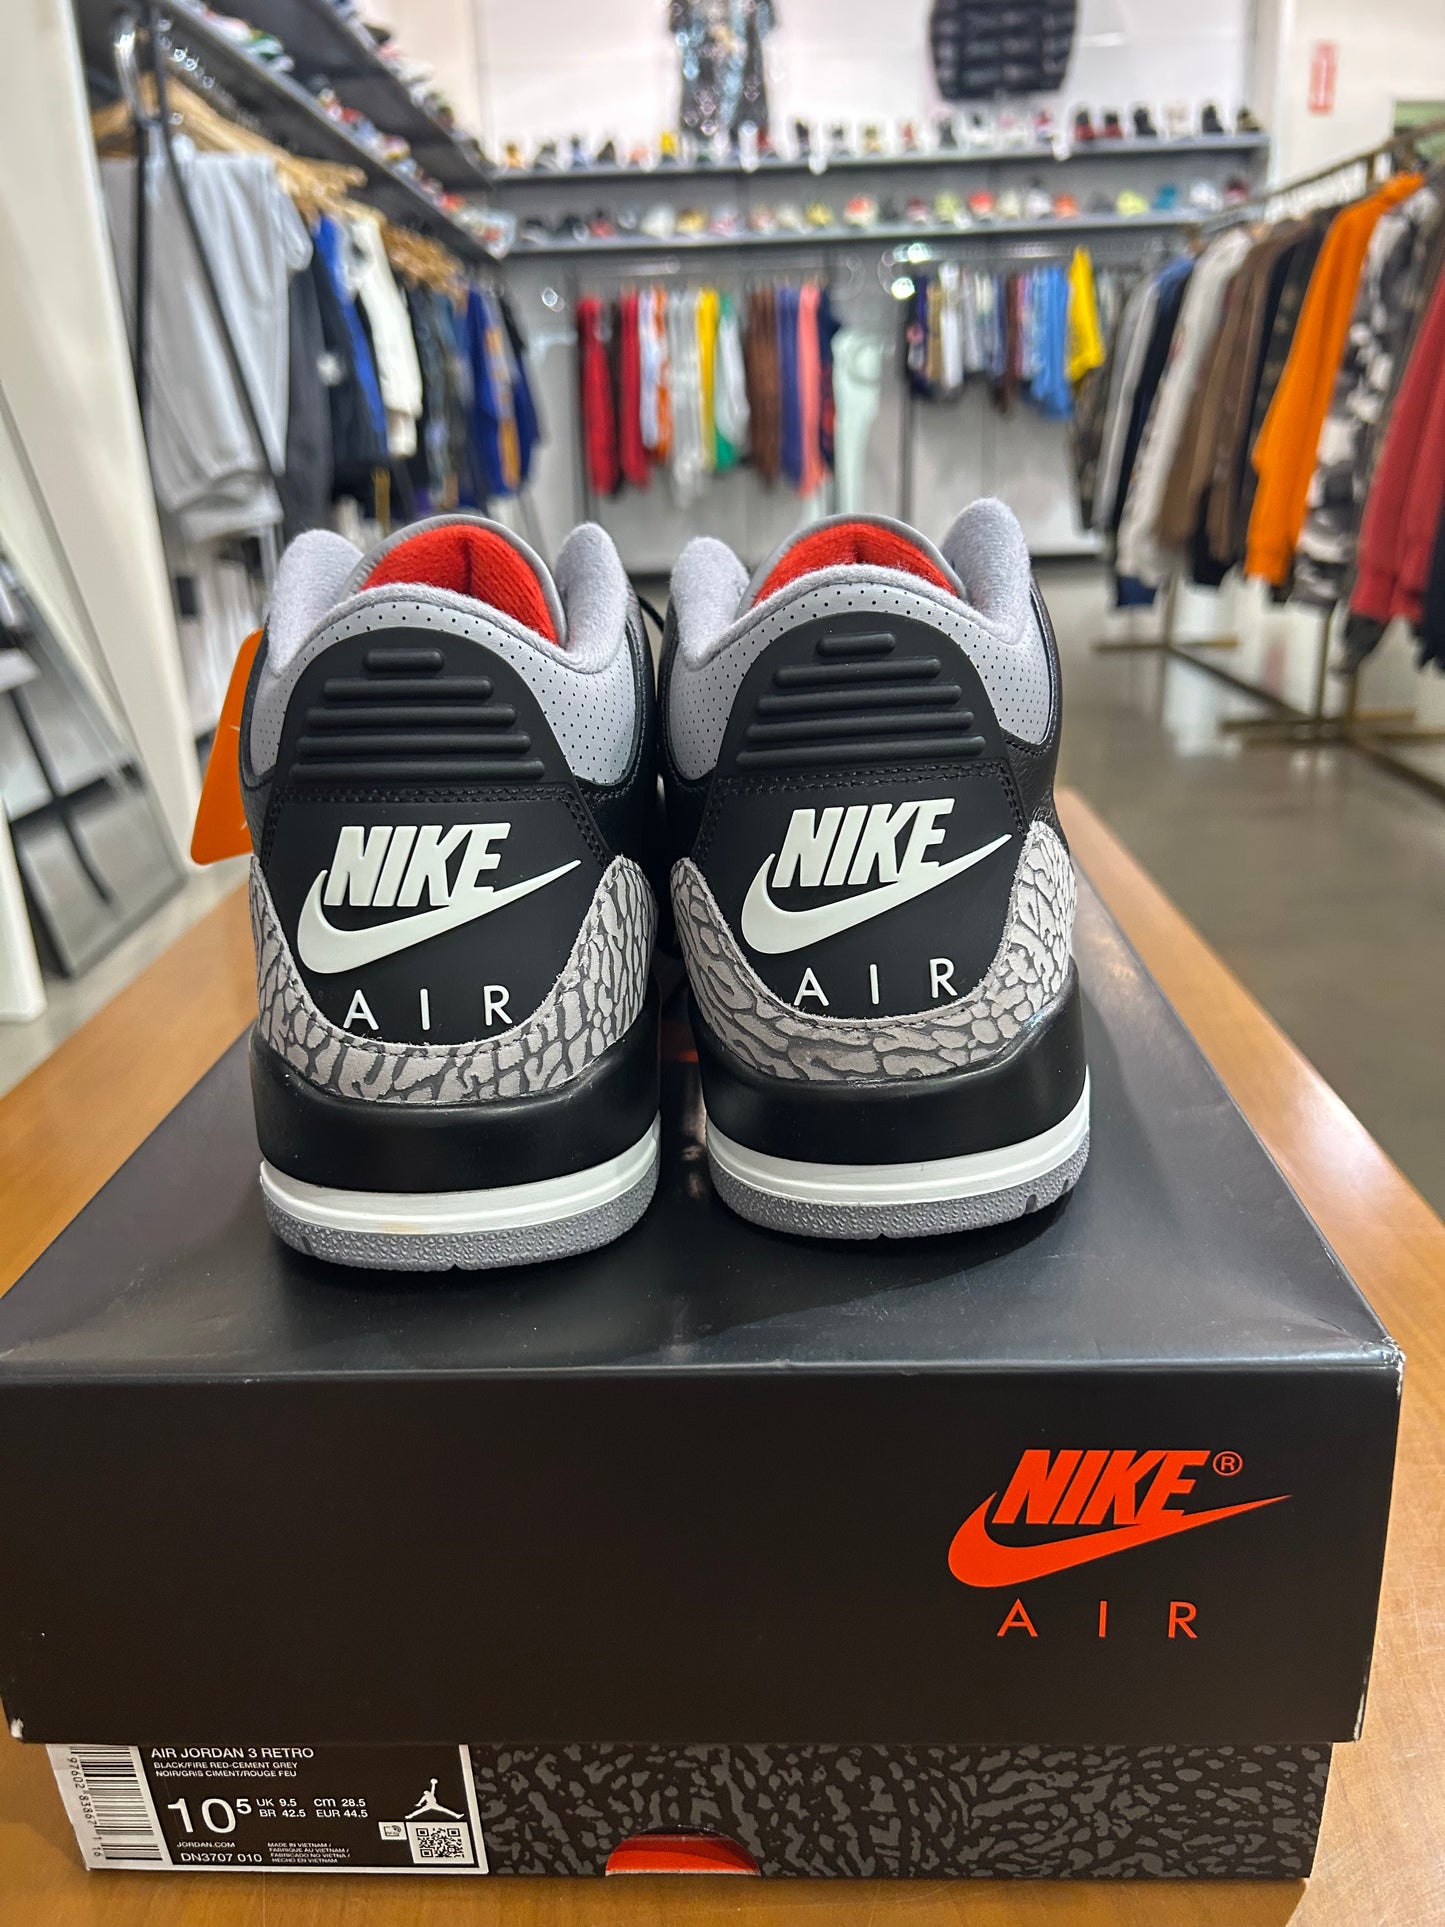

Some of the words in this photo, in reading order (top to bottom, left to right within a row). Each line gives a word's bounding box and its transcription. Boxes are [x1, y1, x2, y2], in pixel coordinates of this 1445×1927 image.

[772, 798, 955, 888] NIKE
[323, 822, 511, 907] NIKE
[151, 1747, 177, 1759] AIR
[180, 1747, 245, 1759] JORDAN
[248, 1747, 258, 1759] 3
[261, 1747, 315, 1759] RETRO
[153, 1761, 208, 1769] BLACK/FIRE
[210, 1761, 270, 1769] RED-CEMENT
[272, 1761, 298, 1769] GREY
[256, 1798, 274, 1807] UK
[279, 1798, 297, 1807] 9.5
[341, 1798, 366, 1807] 28.5
[259, 1809, 277, 1818] BR
[281, 1809, 307, 1818] 42.5
[316, 1809, 341, 1818] EUR
[343, 1809, 369, 1818] 44.5
[180, 1852, 233, 1862] DN3707
[237, 1853, 263, 1863] 010
